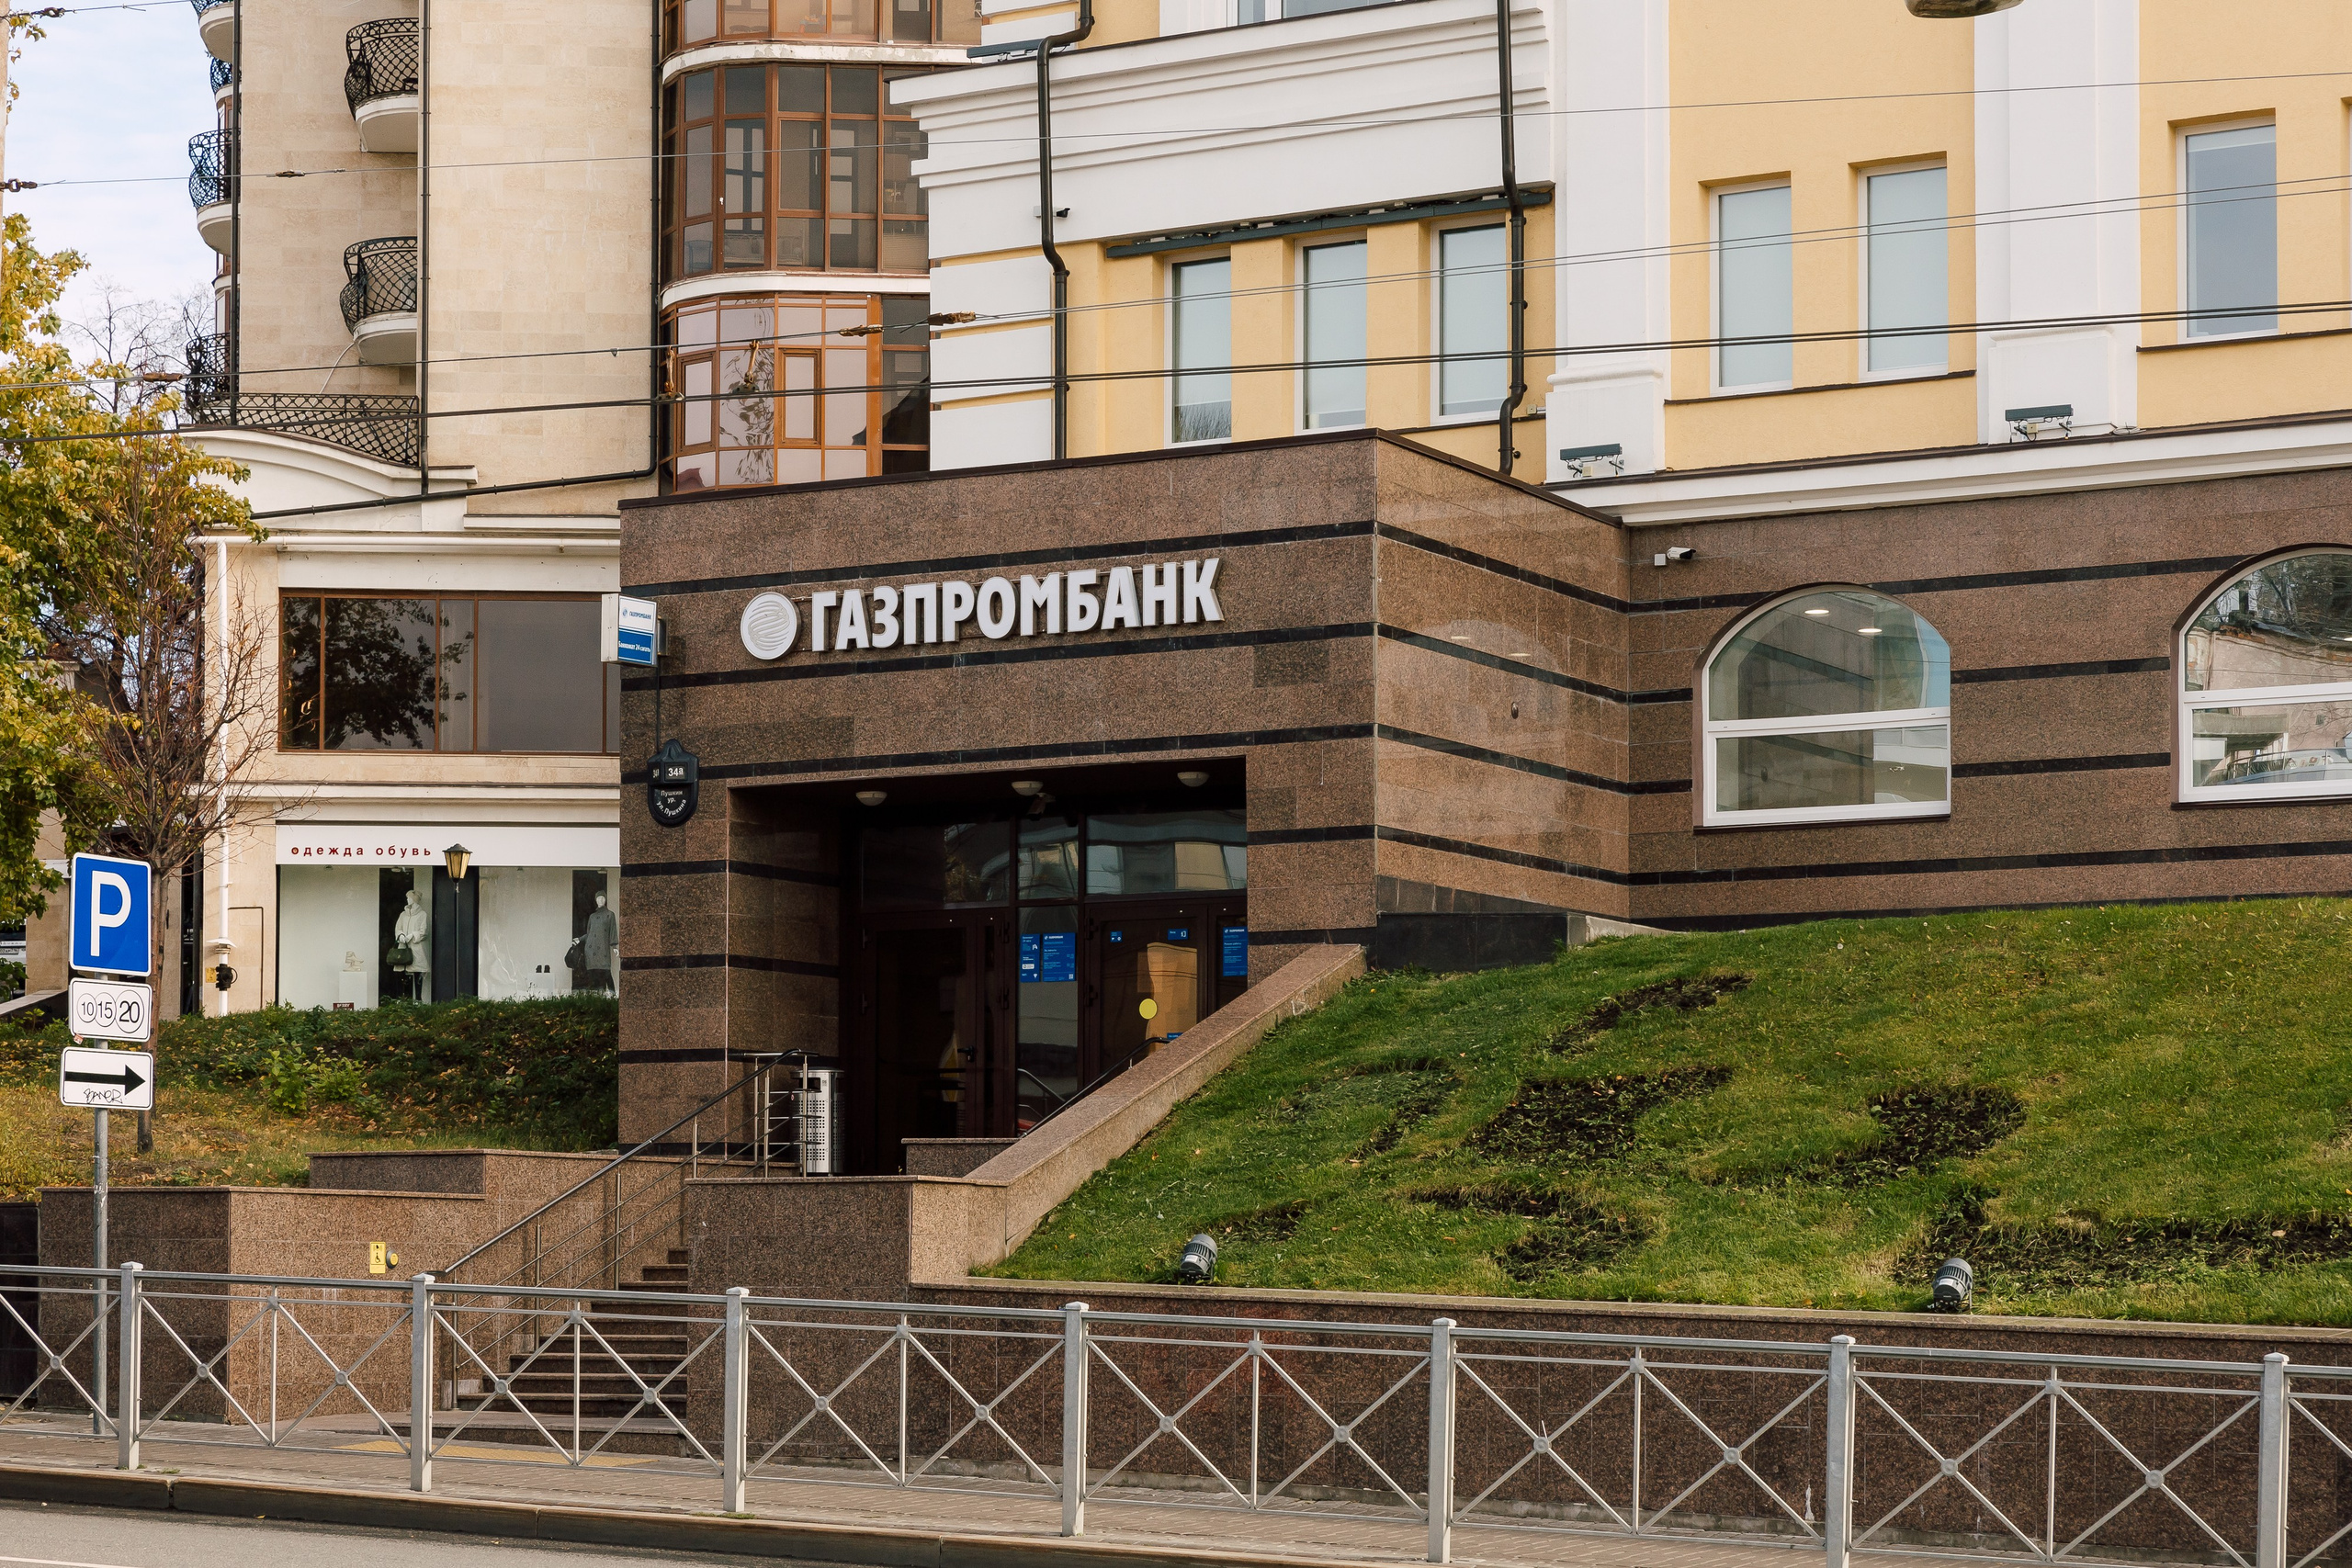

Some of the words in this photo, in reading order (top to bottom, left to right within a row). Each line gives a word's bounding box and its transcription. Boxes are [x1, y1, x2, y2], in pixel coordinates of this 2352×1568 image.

[811, 558, 1224, 653] ГАЗПРОМБАНК
[663, 799, 687, 817] Пушкина
[291, 847, 364, 857] одежда
[375, 845, 431, 858] обувь
[90, 870, 132, 957] P
[81, 1000, 95, 1017] 10
[97, 1000, 113, 1020] 15
[119, 999, 141, 1024] 20
